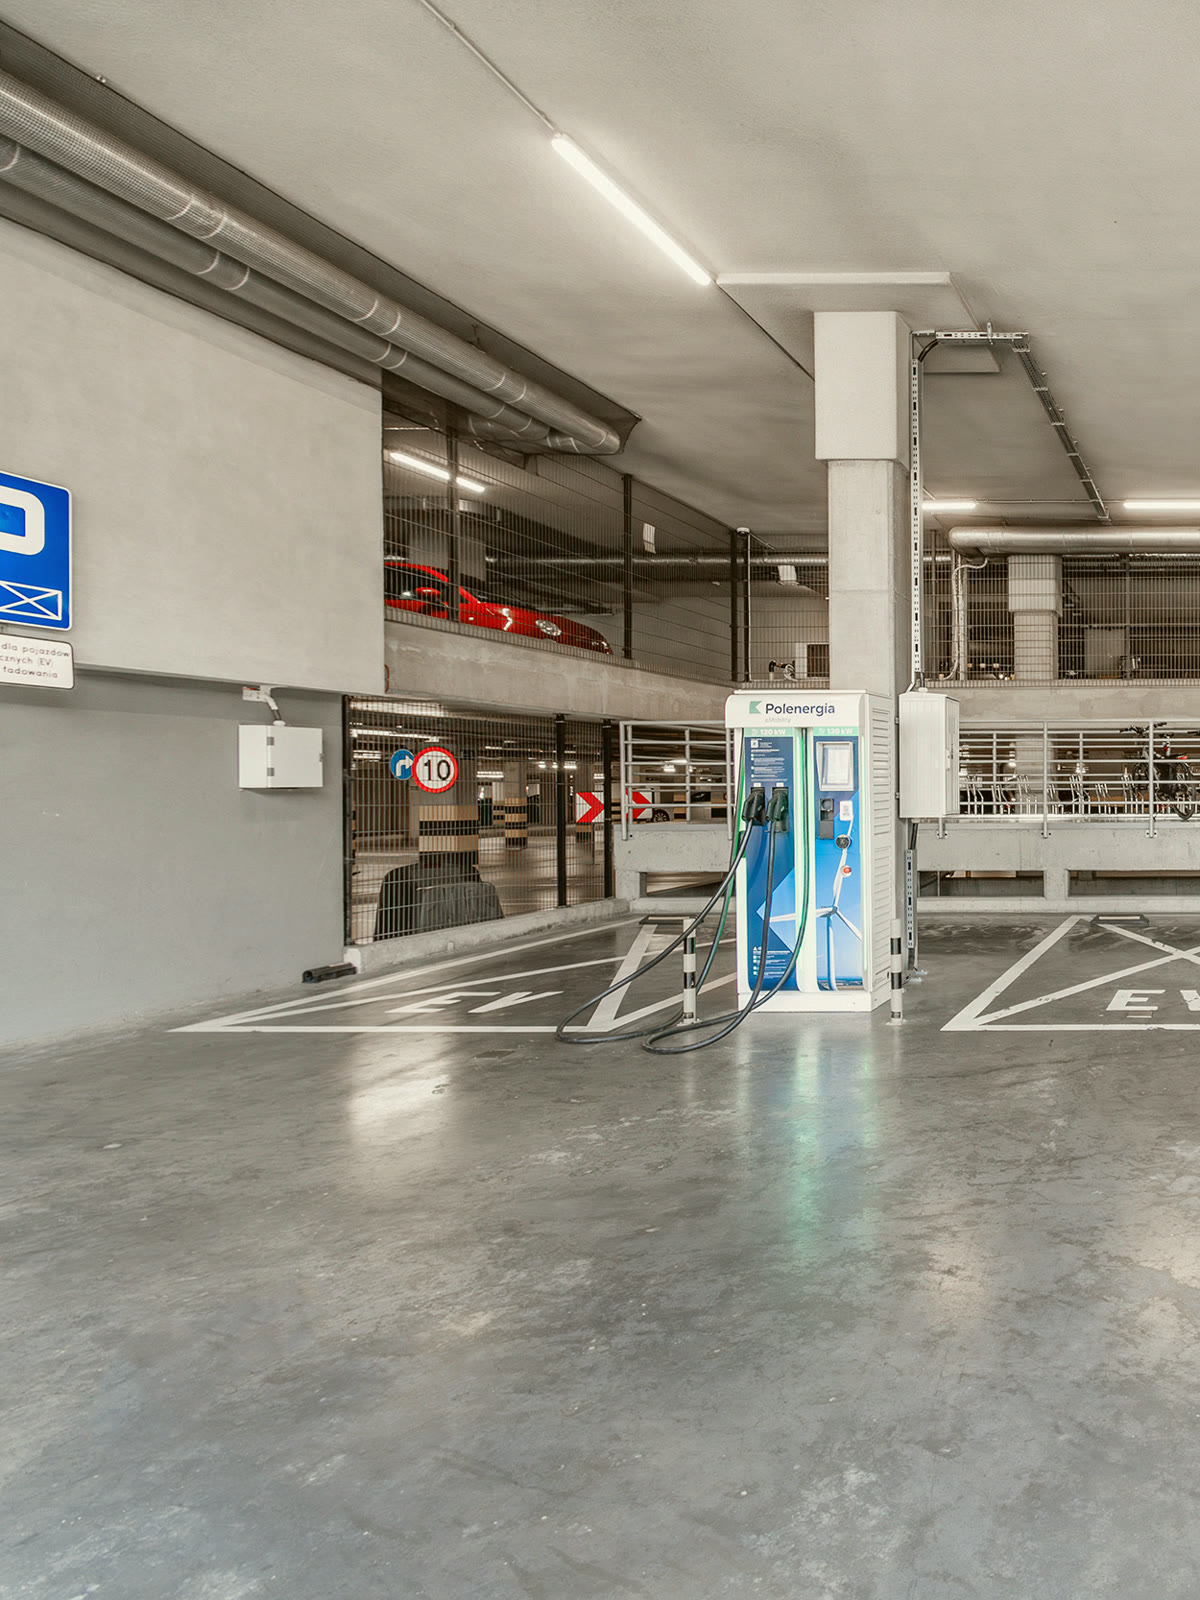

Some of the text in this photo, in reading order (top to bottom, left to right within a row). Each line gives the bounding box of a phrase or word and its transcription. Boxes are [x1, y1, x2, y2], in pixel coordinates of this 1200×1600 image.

[2, 643, 18, 651] dla
[765, 703, 835, 717] Polenergia
[424, 759, 451, 781] 10
